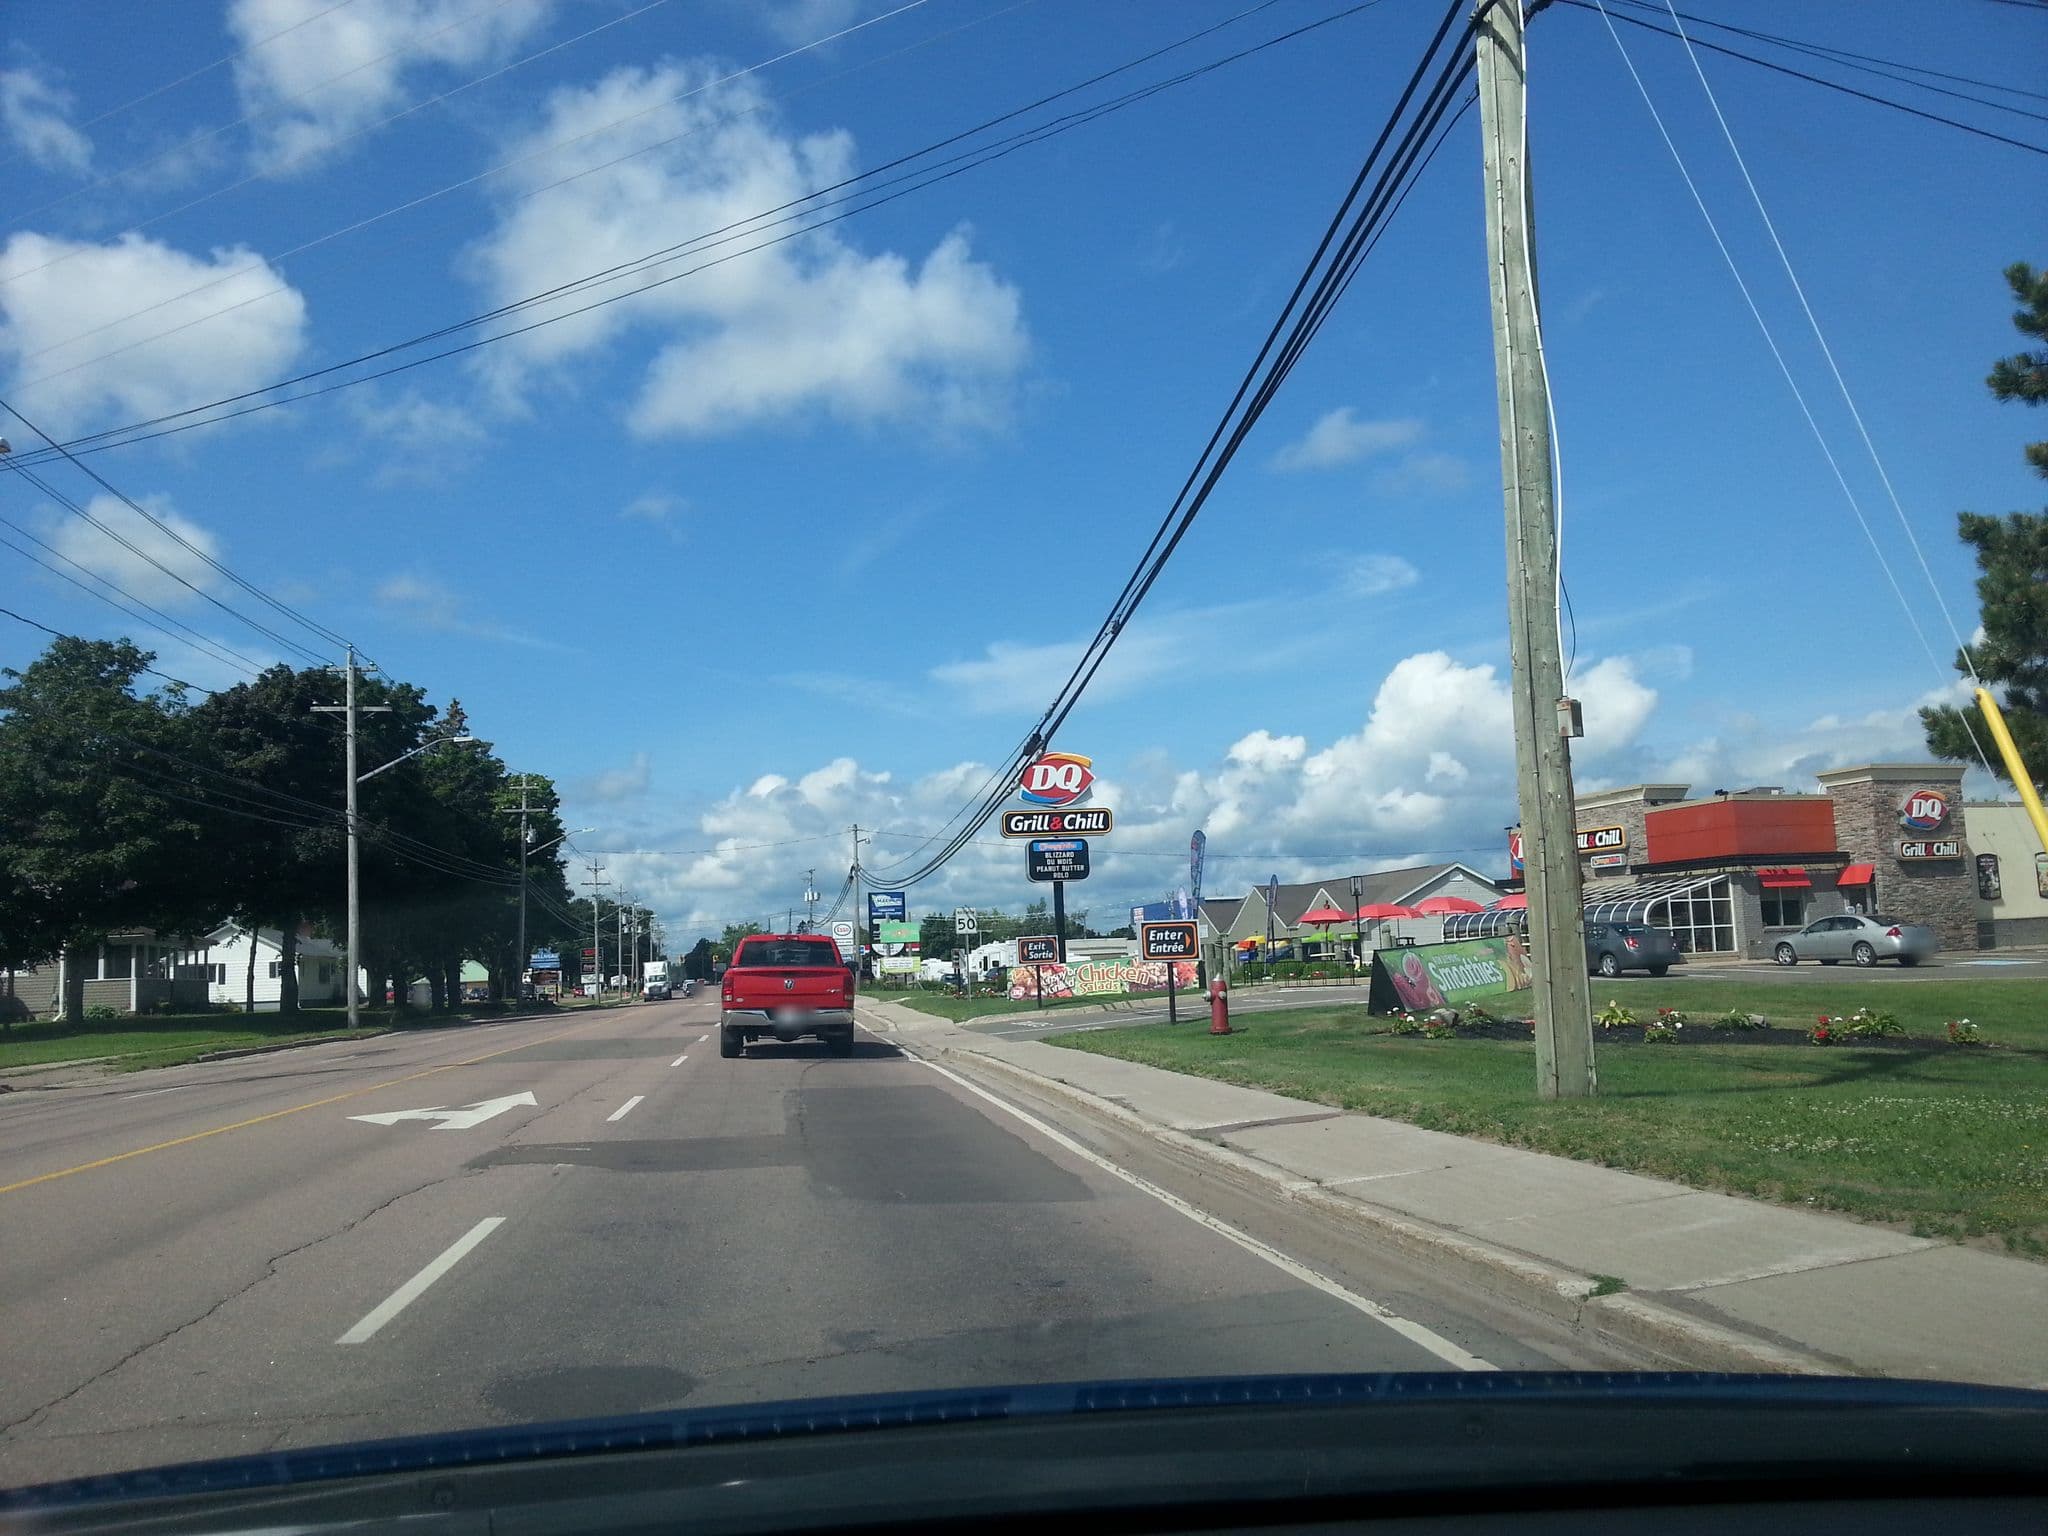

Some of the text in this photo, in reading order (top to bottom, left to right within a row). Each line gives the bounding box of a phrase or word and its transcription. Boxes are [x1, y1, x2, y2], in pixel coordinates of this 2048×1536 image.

[1030, 764, 1082, 793] DQ
[1912, 799, 1941, 820] DQ
[958, 918, 975, 931] 50
[1149, 929, 1183, 941] Enter
[1028, 942, 1046, 951] Exit
[1149, 941, 1184, 954] Entrée
[1028, 950, 1054, 960] Sortie
[1077, 961, 1151, 985] Chicken
[1428, 956, 1504, 992] Smoothies
[1077, 980, 1120, 994] Salads
